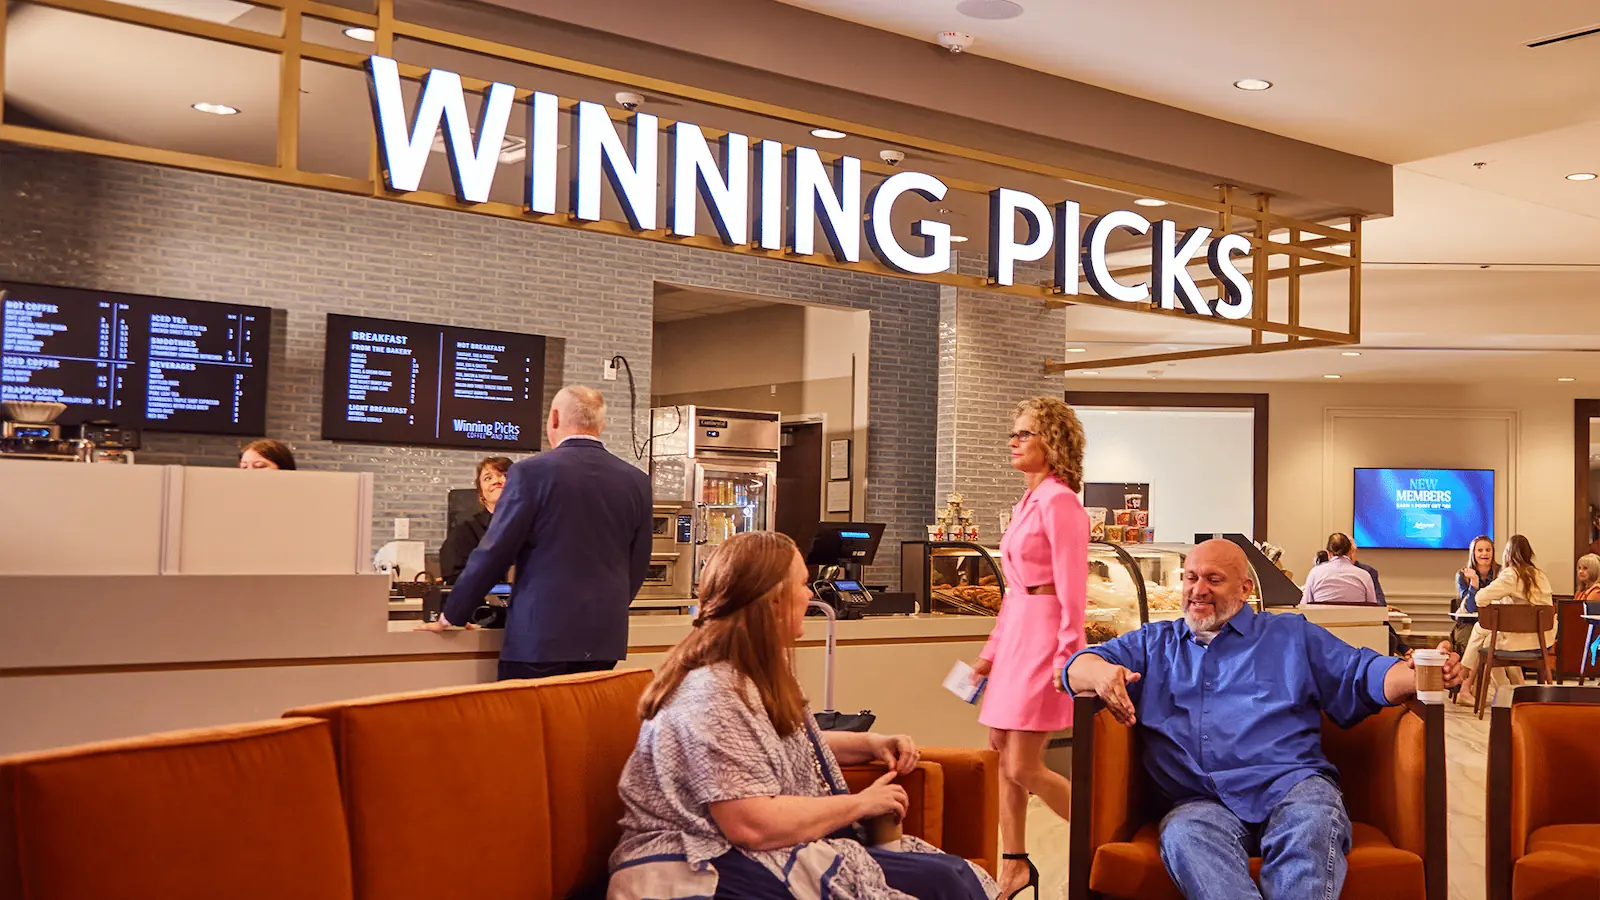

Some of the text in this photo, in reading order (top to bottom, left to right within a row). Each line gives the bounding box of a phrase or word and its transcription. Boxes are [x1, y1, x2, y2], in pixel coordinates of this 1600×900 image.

[367, 55, 1253, 320] WINNING PICKS
[25, 302, 59, 313] COFFEE
[151, 314, 188, 324] ICED TEA
[151, 337, 197, 347] SMOOTHIES
[351, 331, 408, 345] BREAKFAST
[351, 344, 371, 352] FROM
[386, 347, 412, 355] BAKERY
[471, 343, 505, 352] BREAKFAST
[3, 357, 25, 365] ICED
[27, 358, 60, 368] COFFEE
[150, 361, 196, 370] BEVERAGES
[2, 385, 64, 396] FRAPPUCCINO
[369, 406, 408, 414] BREAKFAST
[453, 418, 520, 436] Winning Picks
[504, 433, 518, 441] MORE
[1410, 478, 1438, 489] NEW
[1396, 490, 1452, 502] MEMBERS
